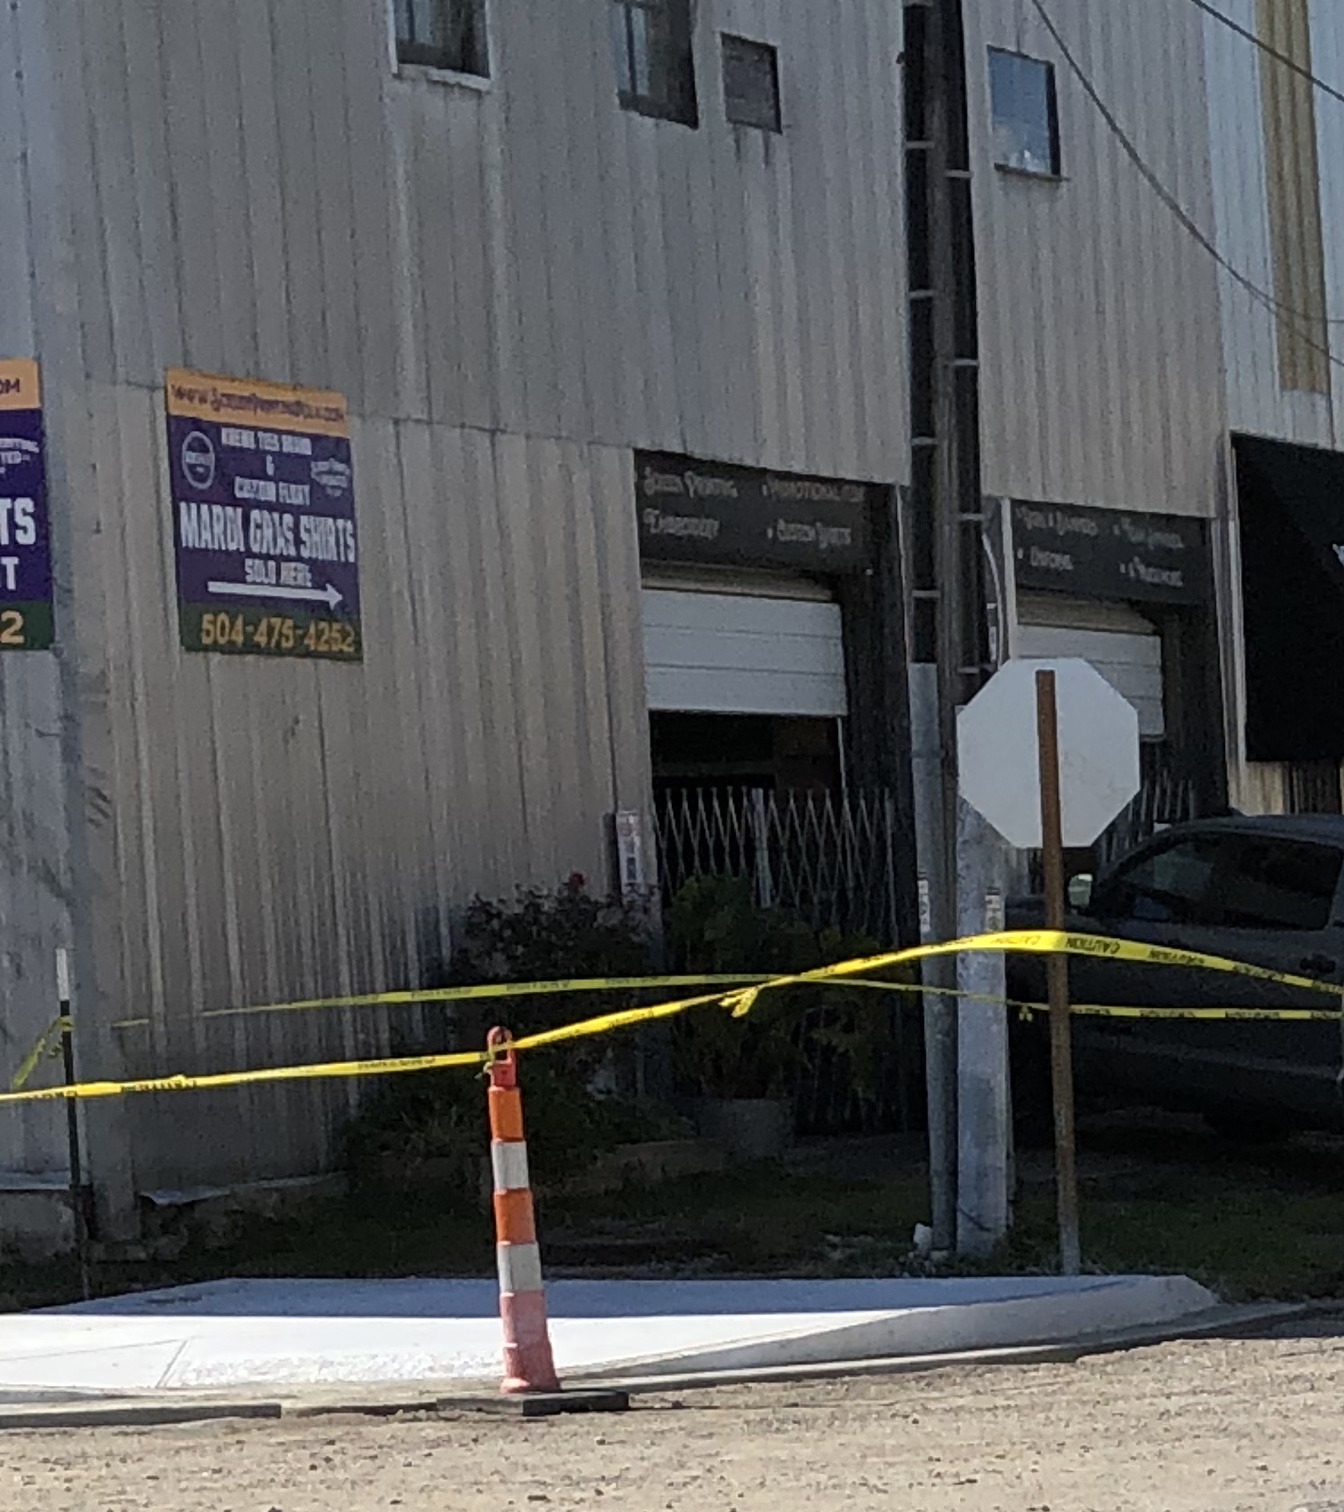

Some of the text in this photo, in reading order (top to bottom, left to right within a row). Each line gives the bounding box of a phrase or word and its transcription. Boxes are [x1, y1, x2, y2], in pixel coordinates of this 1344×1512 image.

[179, 501, 356, 563] MARDI GRAS SHIRTS
[201, 611, 356, 653] 504-475-4252
[1065, 936, 1122, 956] CAUTION
